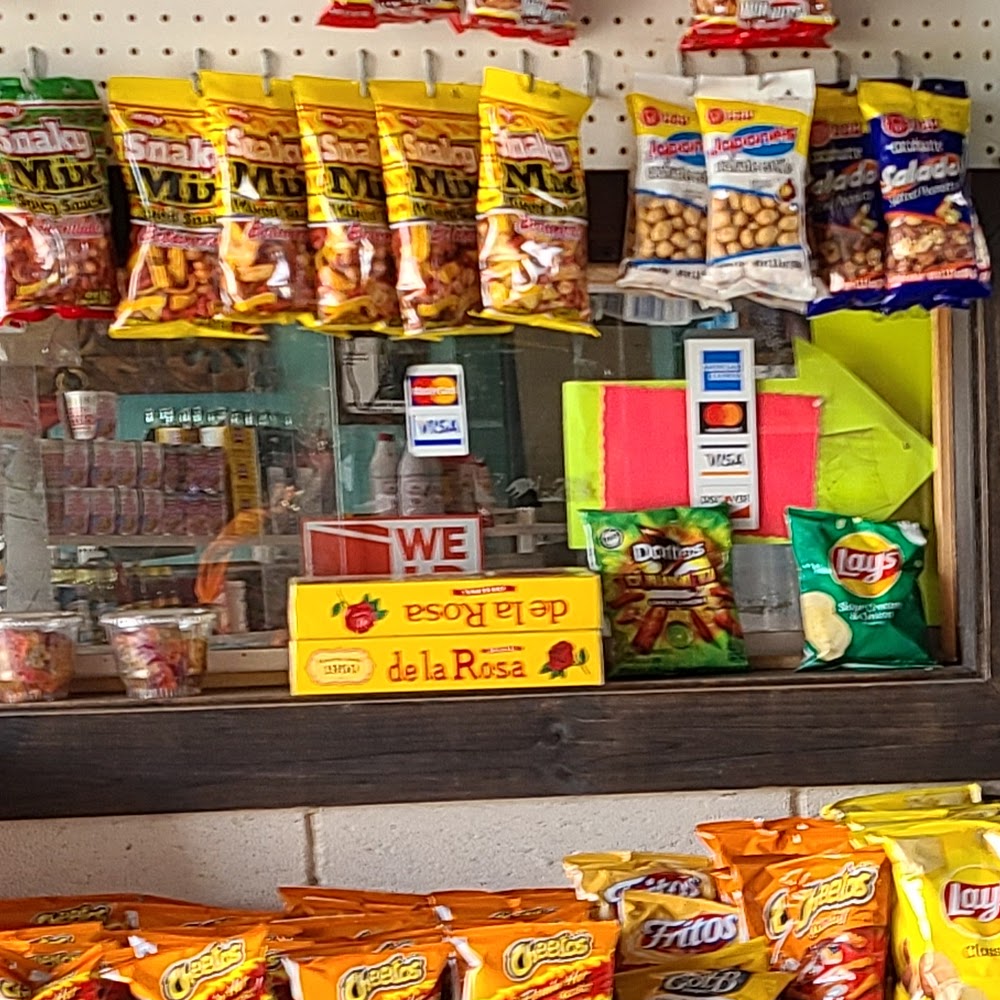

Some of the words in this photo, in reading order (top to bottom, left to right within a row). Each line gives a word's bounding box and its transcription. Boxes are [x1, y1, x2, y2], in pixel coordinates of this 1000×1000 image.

[11, 158, 98, 190] Mix
[399, 527, 468, 561] WE
[405, 602, 487, 628] Rosa
[494, 600, 526, 627] la
[530, 599, 568, 625] de
[388, 650, 418, 682] de
[421, 650, 447, 681] la
[451, 648, 526, 681] Rosa
[642, 912, 740, 951] Fritos
[504, 930, 592, 981] Cheetos
